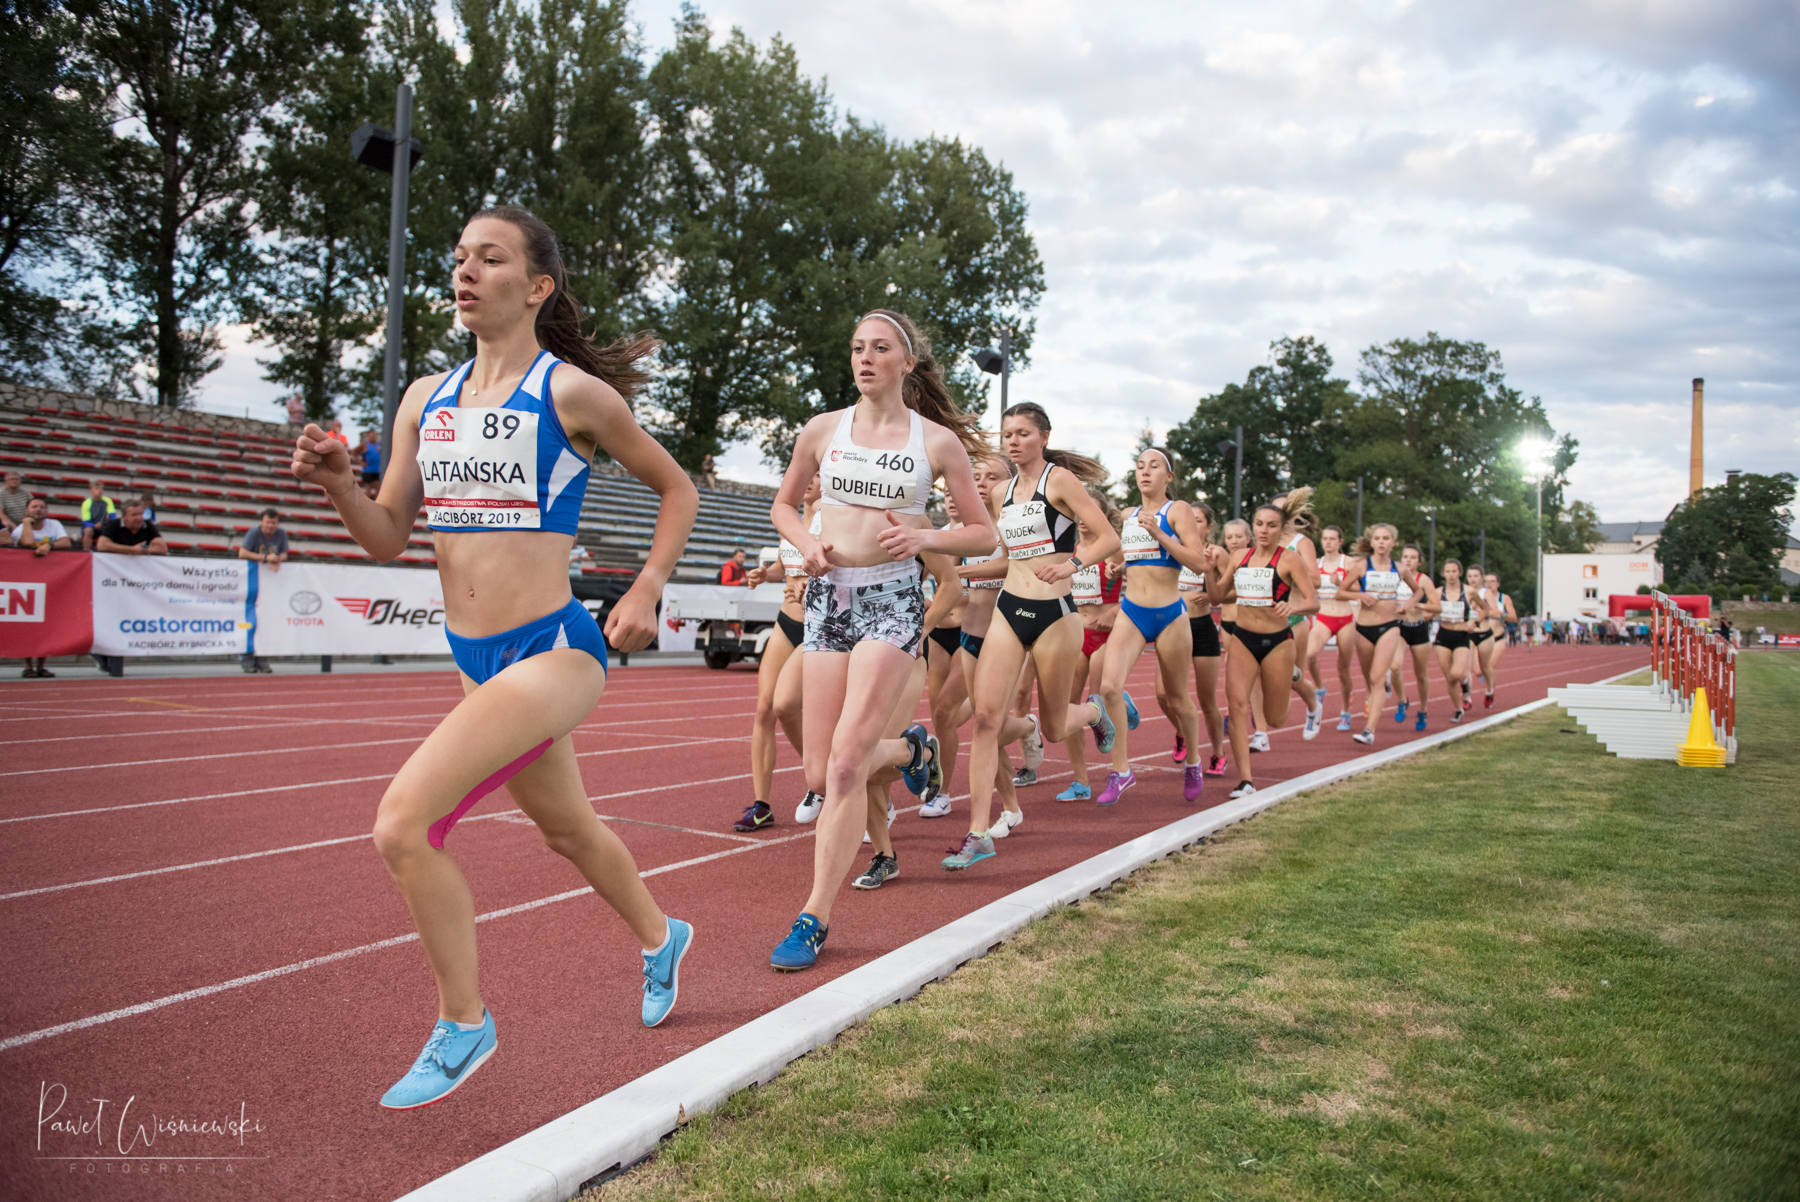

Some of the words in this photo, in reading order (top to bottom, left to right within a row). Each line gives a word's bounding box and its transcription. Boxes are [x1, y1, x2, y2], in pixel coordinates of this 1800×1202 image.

[482, 412, 521, 440] 89
[425, 430, 453, 441] ORLEN
[842, 454, 868, 463] Racibórz
[875, 453, 914, 473] 460
[422, 456, 526, 484] LATAŃSKA
[832, 476, 905, 499] DUBIELLA
[1022, 503, 1043, 517] 262
[487, 512, 522, 524] 2019
[1005, 525, 1037, 540] DUDEK
[1030, 546, 1046, 556] 2019
[182, 566, 239, 579] Wszystko
[1253, 569, 1271, 578] 370
[101, 578, 118, 588] dla
[119, 578, 164, 591] Twojego
[165, 579, 195, 590] domu
[201, 581, 239, 592] ogrodu!
[975, 580, 1004, 588] RACIBÓRZ
[1237, 583, 1266, 592] MATYSIK
[119, 616, 235, 633] castorama
[286, 617, 325, 627] TOYOTA
